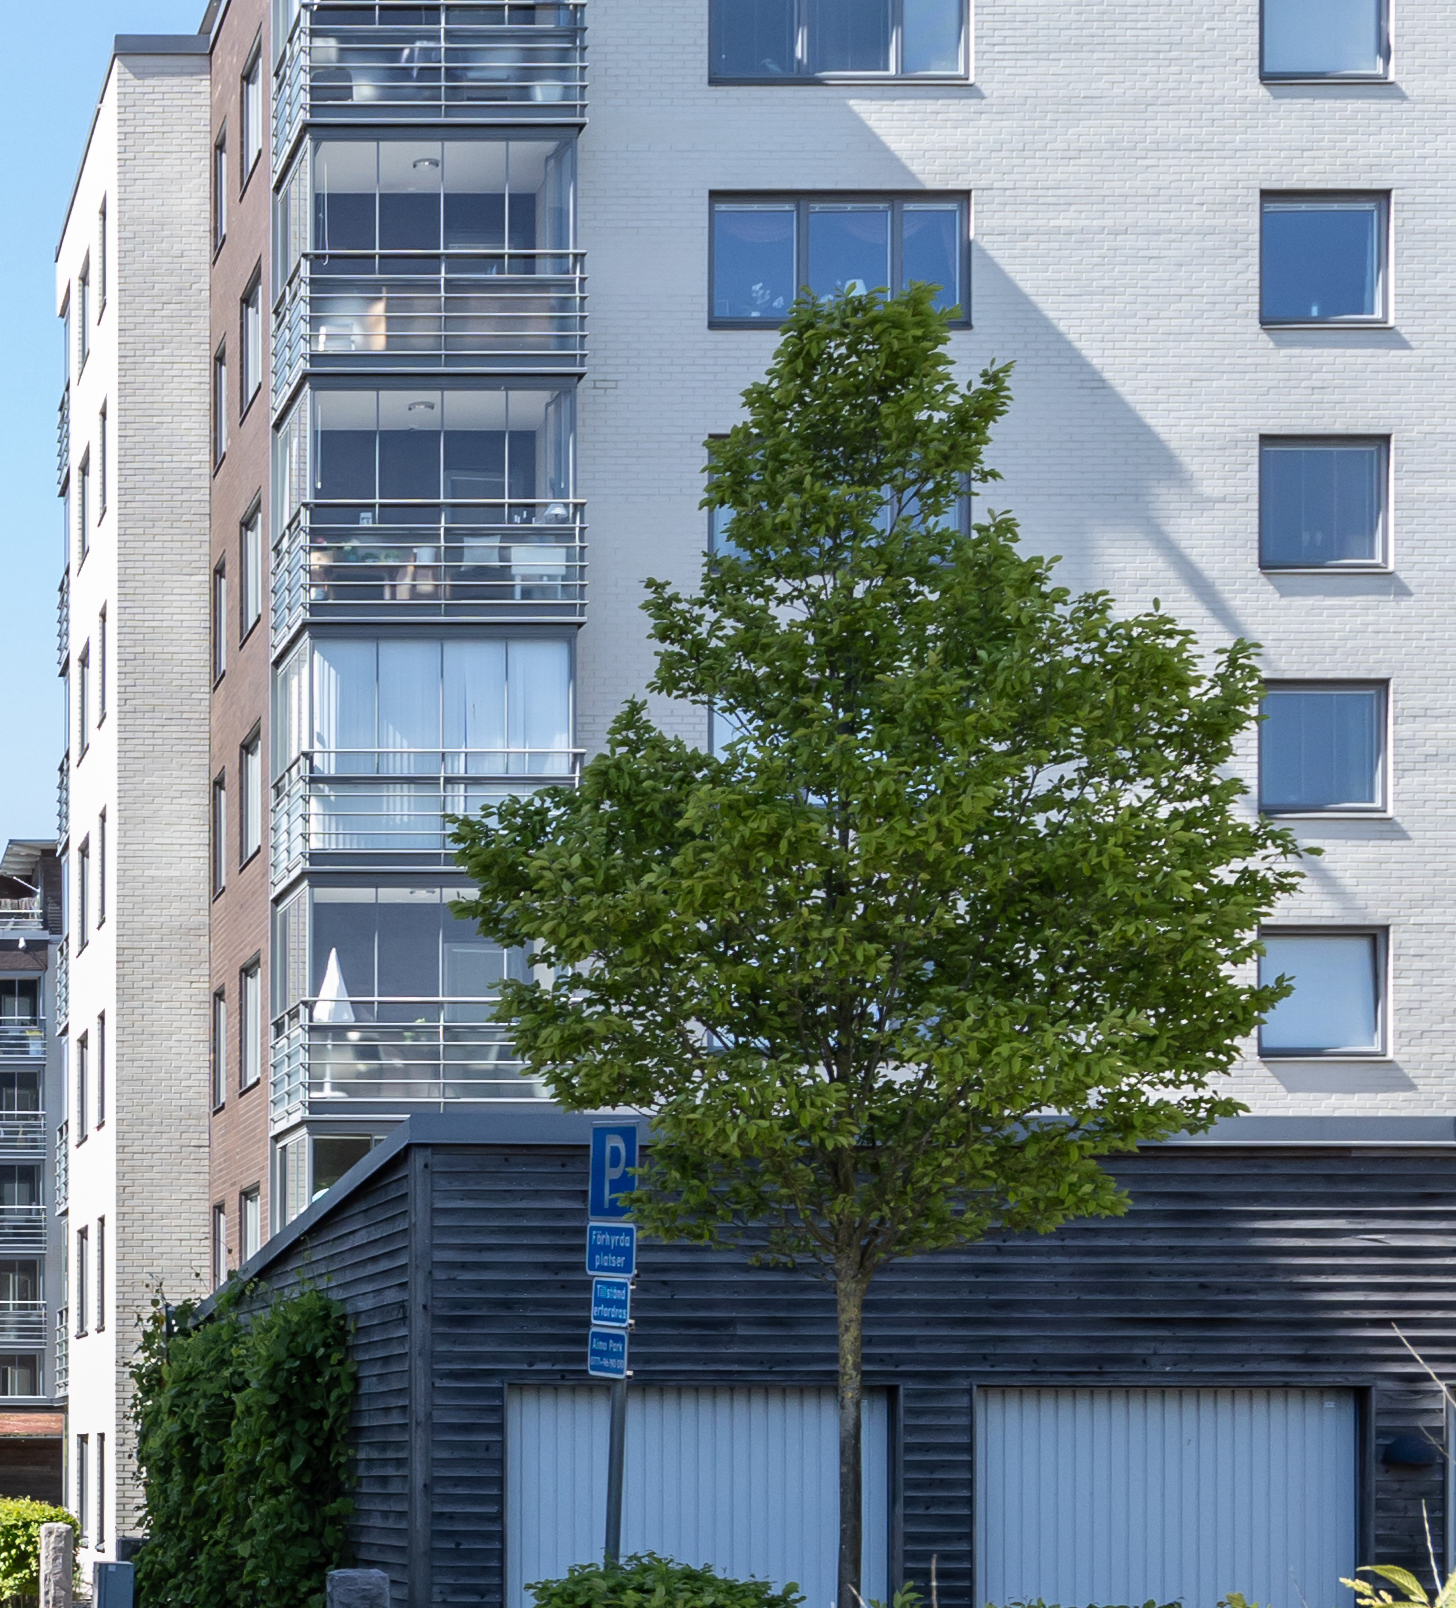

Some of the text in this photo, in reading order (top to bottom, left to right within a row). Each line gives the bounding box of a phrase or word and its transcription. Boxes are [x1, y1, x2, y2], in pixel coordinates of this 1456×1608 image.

[603, 1133, 626, 1208] P
[591, 1230, 630, 1249] Förhyrda
[595, 1251, 626, 1269] platser
[593, 1304, 627, 1319] erfordras
